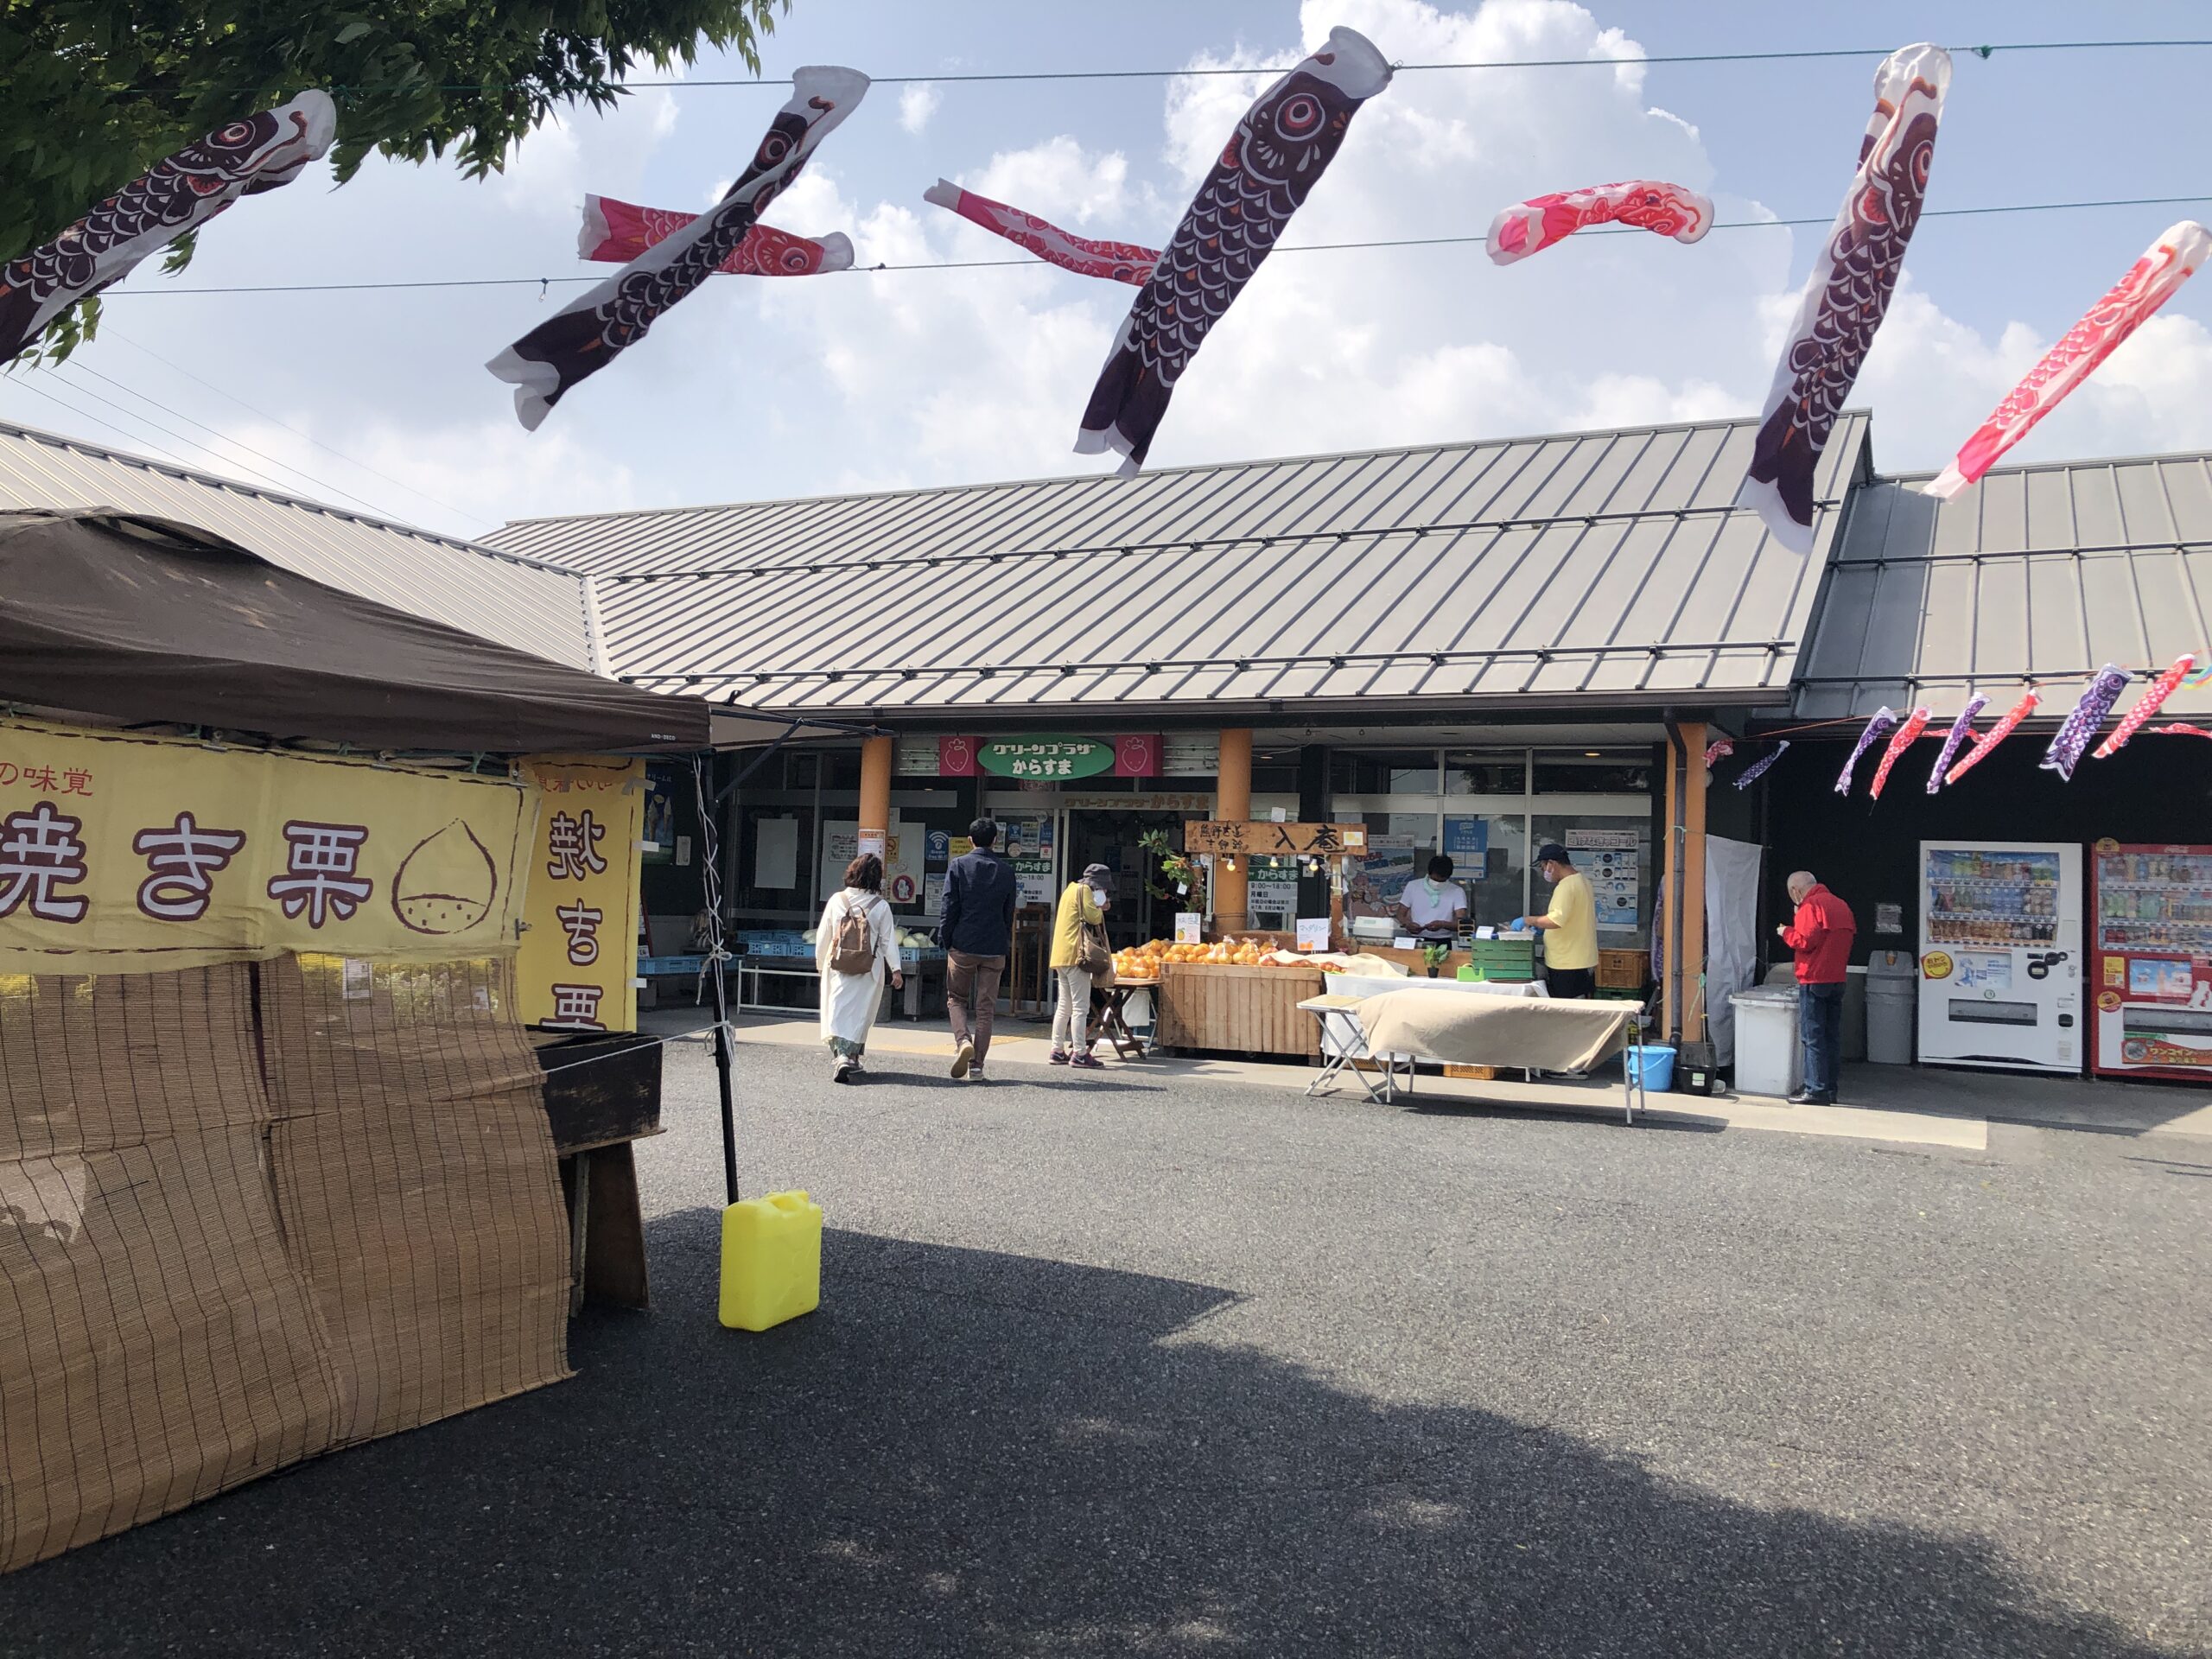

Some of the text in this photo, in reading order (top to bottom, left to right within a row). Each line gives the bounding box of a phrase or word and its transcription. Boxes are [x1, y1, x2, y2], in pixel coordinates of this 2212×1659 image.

[993, 742, 1096, 755] グリーンプラザ
[1012, 759, 1072, 775] からすま
[0, 762, 93, 797] の味覚
[1150, 794, 1210, 809] からすま
[0, 800, 374, 929] 焼き栗
[1015, 861, 1052, 872] からすま
[1257, 868, 1299, 880] からすま
